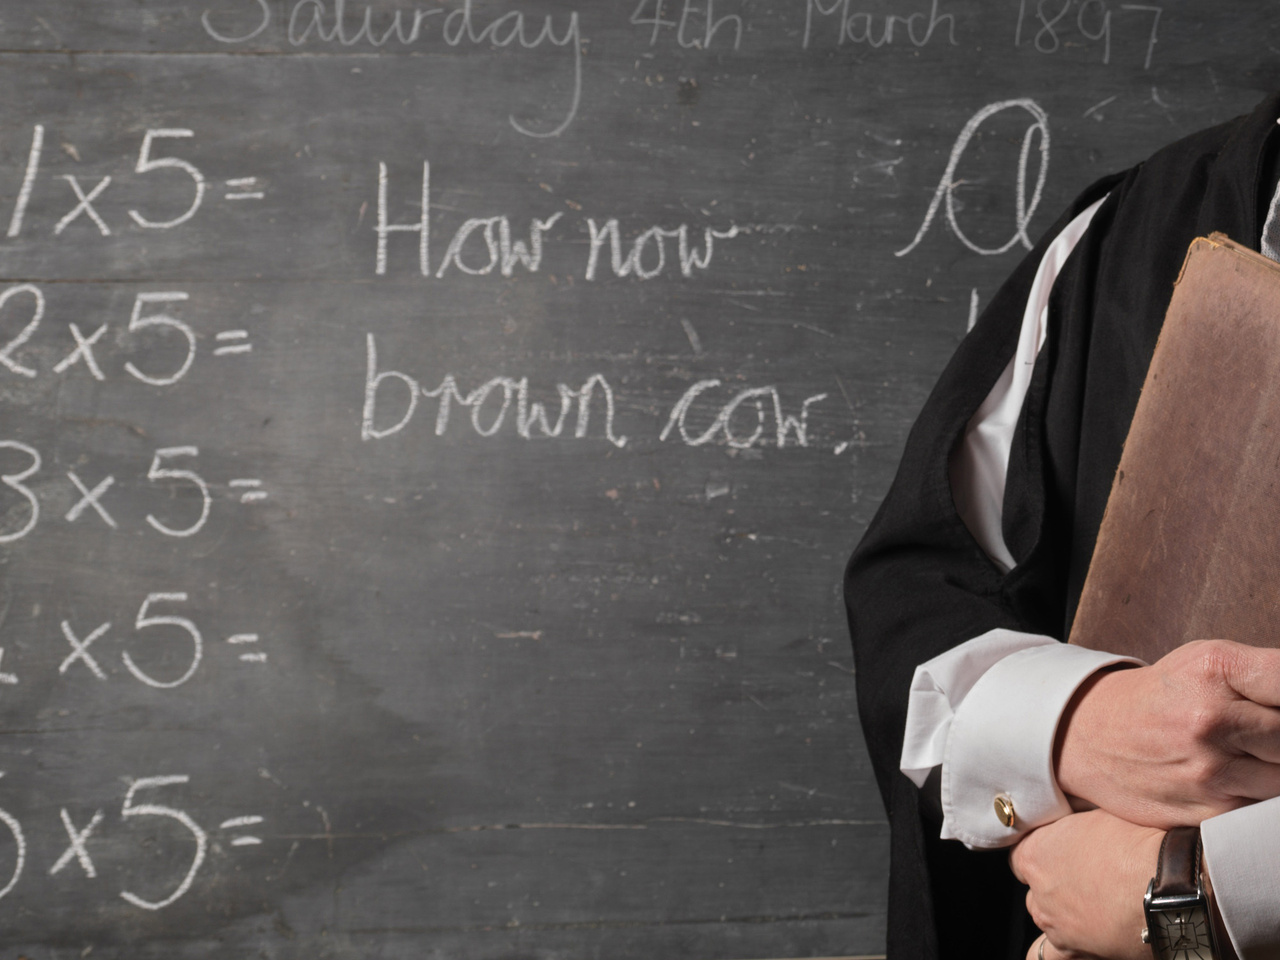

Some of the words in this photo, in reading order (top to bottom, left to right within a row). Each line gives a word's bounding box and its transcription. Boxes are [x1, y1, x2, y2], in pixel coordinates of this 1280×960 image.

[373, 160, 563, 279] How
[585, 217, 739, 281] now
[361, 332, 626, 448] brown
